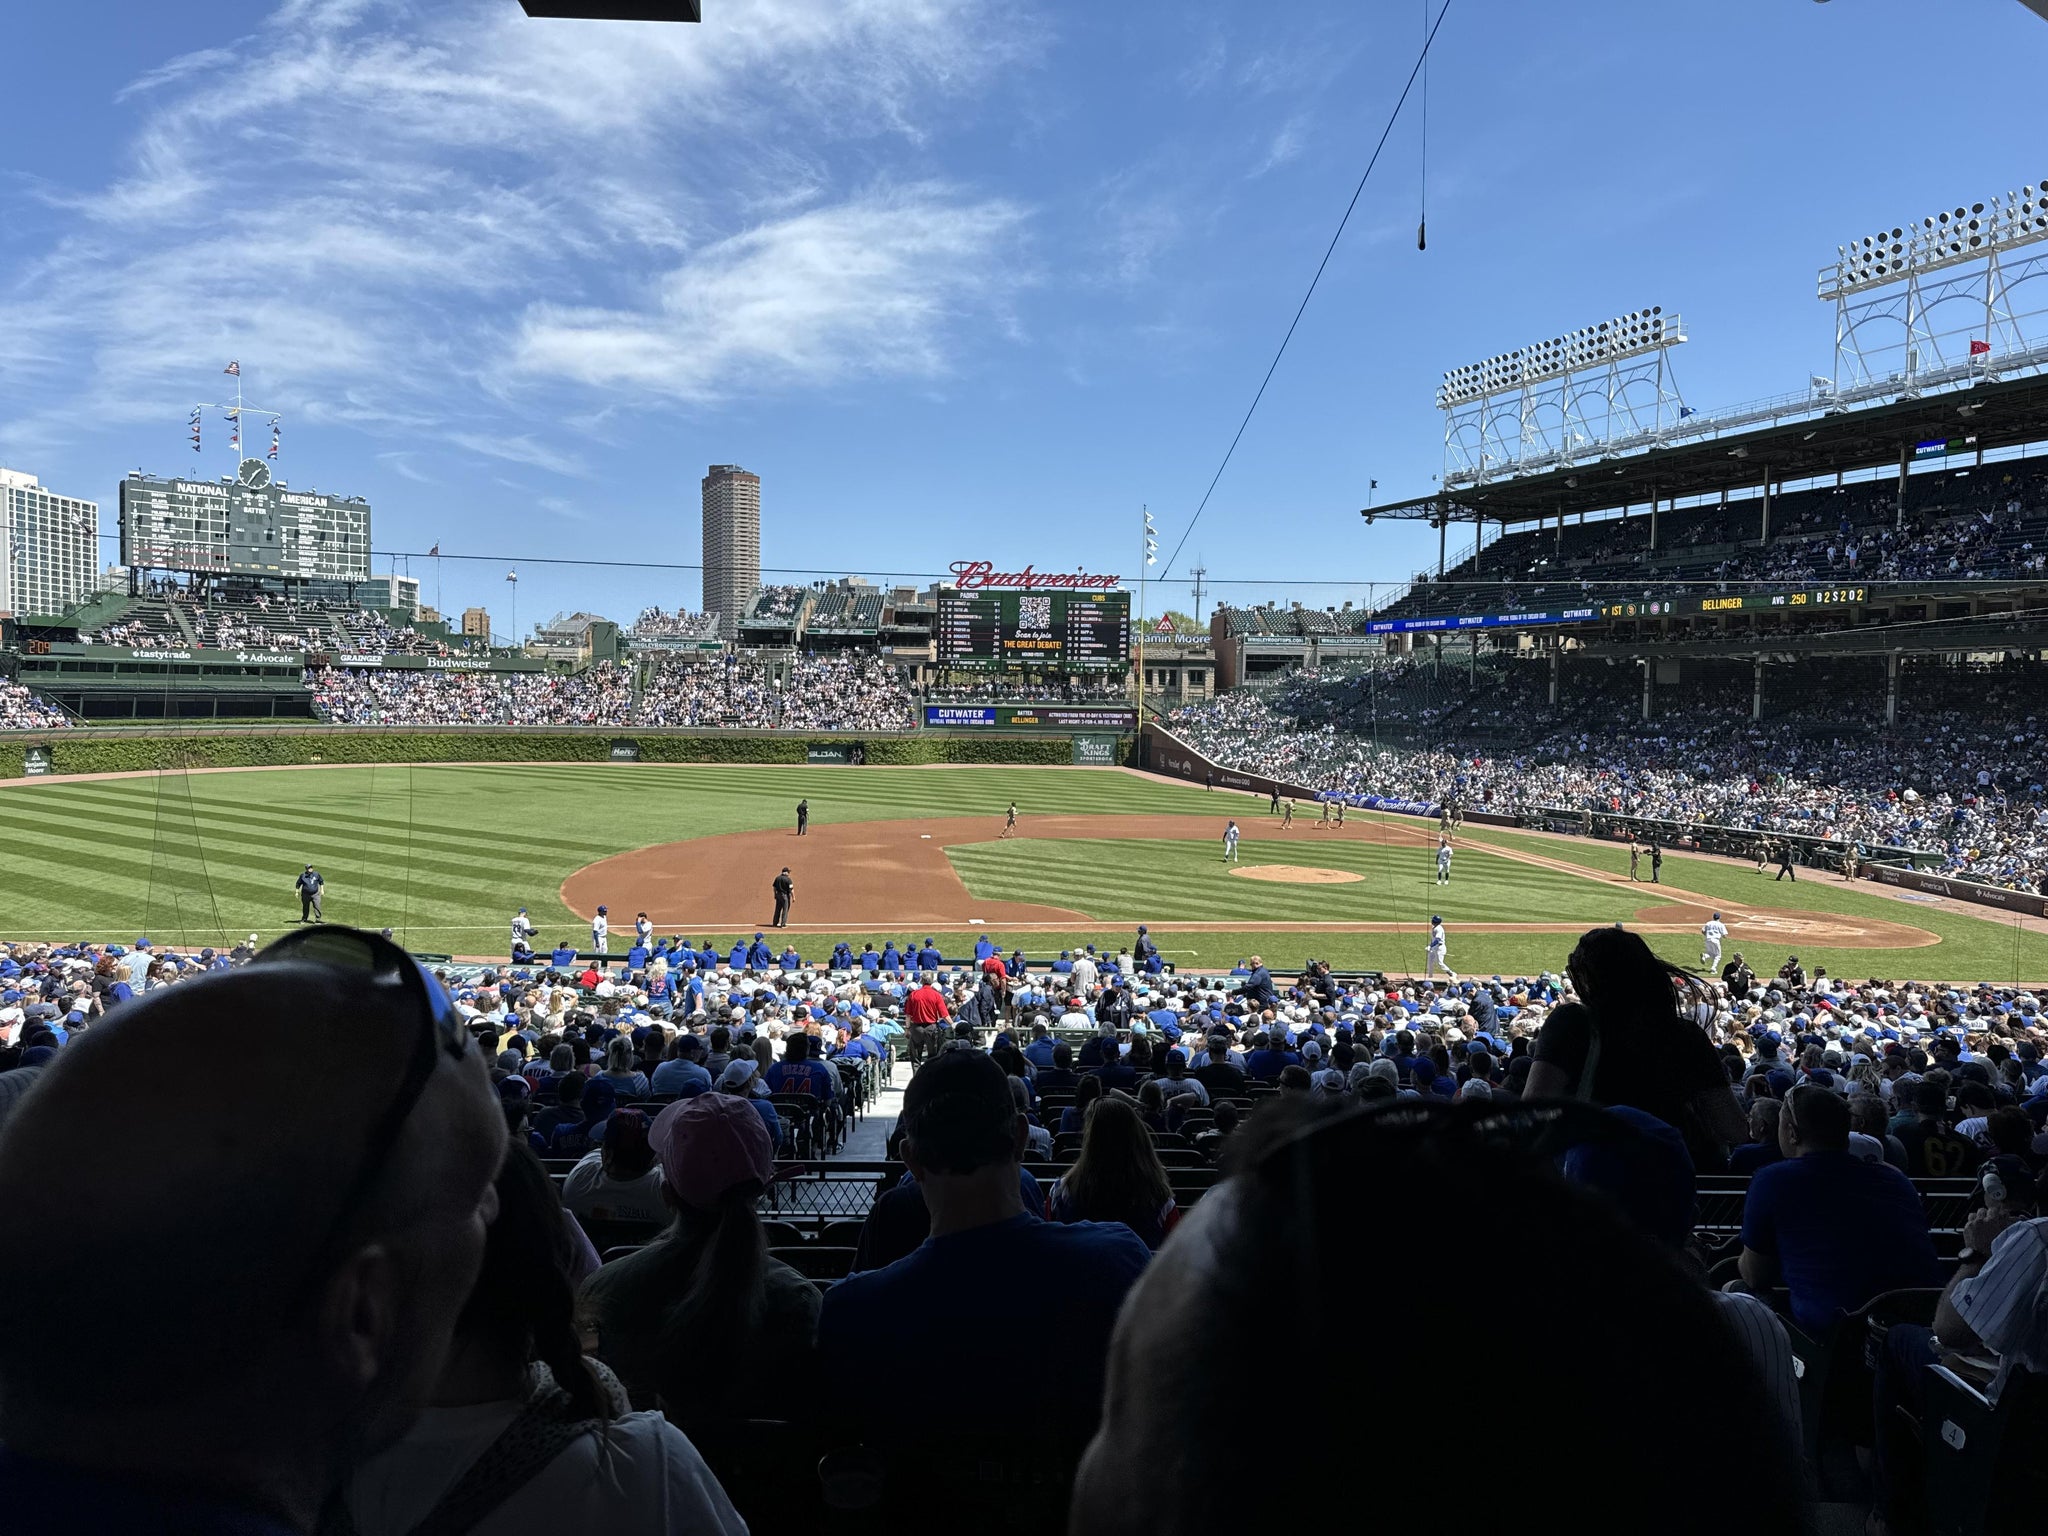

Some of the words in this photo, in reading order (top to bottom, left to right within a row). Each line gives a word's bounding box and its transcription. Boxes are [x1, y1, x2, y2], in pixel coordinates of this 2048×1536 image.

[1916, 443, 1946, 454] CUTWATER
[177, 483, 229, 497] NATIONAL
[280, 494, 328, 507] AMERICAN
[950, 561, 1120, 588] Budweiser
[1772, 596, 1785, 605] AVG
[1789, 593, 1807, 605] .250
[1816, 592, 1822, 602] B
[1824, 591, 1830, 603] 2
[1832, 591, 1839, 601] S
[1840, 590, 1846, 602] 2
[1857, 589, 1863, 601] 2
[1702, 598, 1743, 610] BELLINGER
[1563, 609, 1593, 618] CUTWATER
[1015, 630, 1031, 638] Scan
[1037, 632, 1052, 641] join
[1175, 633, 1211, 643] Moore
[1037, 641, 1062, 649] DEBATE!
[140, 650, 191, 659] tastytrade
[250, 654, 294, 662] Advocate
[427, 657, 491, 669] Budweiser
[939, 709, 983, 718] CUTWATER
[25, 760, 48, 768] Benjamin
[1375, 799, 1404, 810] Reynolds
[1405, 802, 1426, 814] Wrap
[1920, 880, 1944, 892] American
[1983, 890, 2006, 902] Advocate
[782, 1064, 811, 1076] RIZZO
[781, 1077, 811, 1093] 44
[1924, 1136, 1965, 1177] 62
[1949, 1429, 1957, 1443] 4
